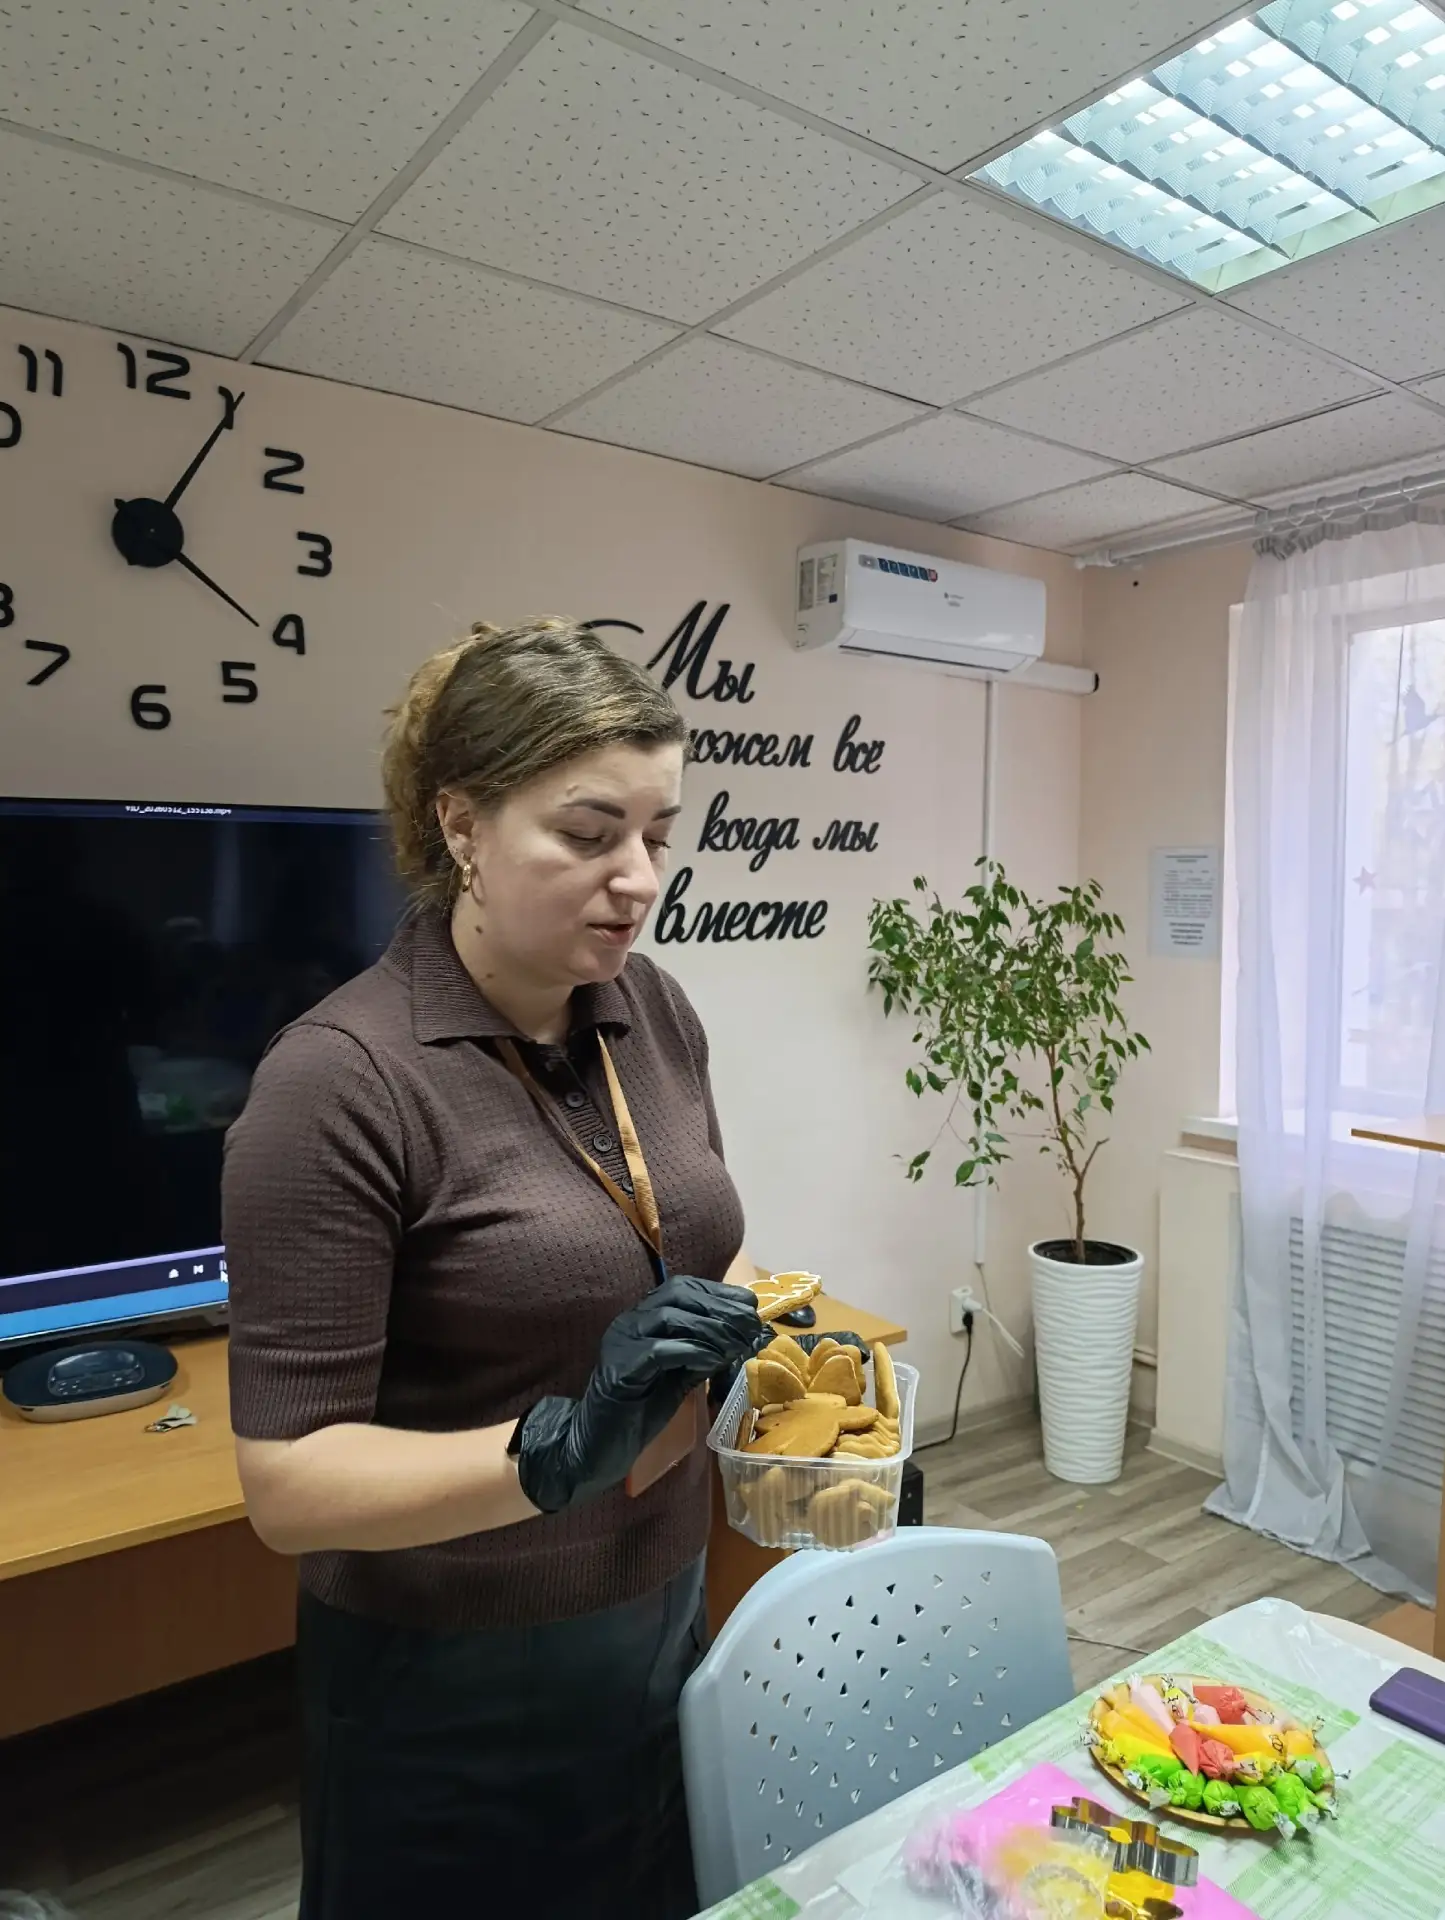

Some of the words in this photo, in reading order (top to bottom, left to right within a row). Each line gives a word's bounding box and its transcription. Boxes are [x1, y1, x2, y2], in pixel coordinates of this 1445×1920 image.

[18, 344, 63, 396] 11
[117, 342, 190, 400] 12
[263, 447, 304, 494] 2
[297, 531, 332, 577] 3
[272, 613, 305, 655] 4
[646, 599, 755, 704] Мы
[25, 639, 70, 686] 7
[221, 661, 257, 703] 5
[131, 685, 171, 730] 6
[690, 728, 814, 767] ожем
[695, 790, 800, 872] когда
[812, 820, 879, 853] мы
[655, 867, 828, 944] вместе
